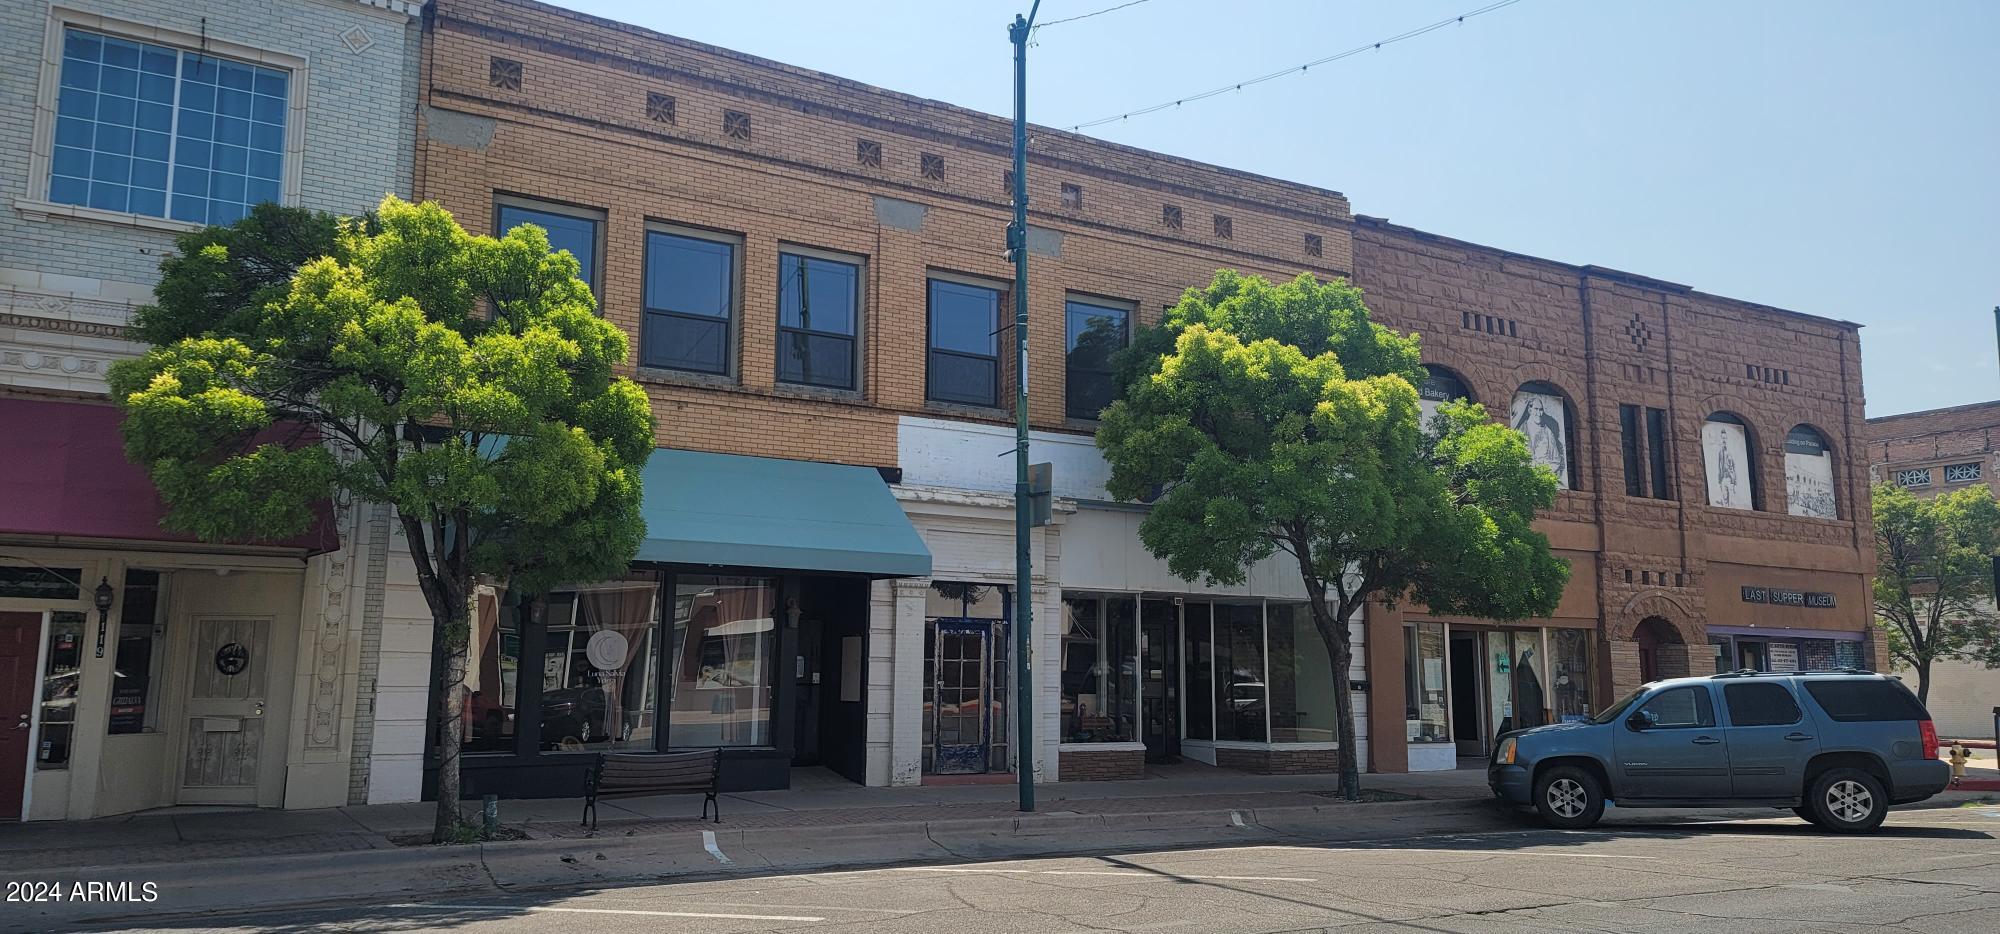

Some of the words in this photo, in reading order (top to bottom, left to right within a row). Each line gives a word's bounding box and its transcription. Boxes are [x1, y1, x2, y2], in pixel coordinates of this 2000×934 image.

[1424, 387, 1450, 400] Bakery
[1745, 590, 1767, 601] LAST
[1773, 592, 1804, 604] SUPPER
[1808, 595, 1837, 607] MUSEUM
